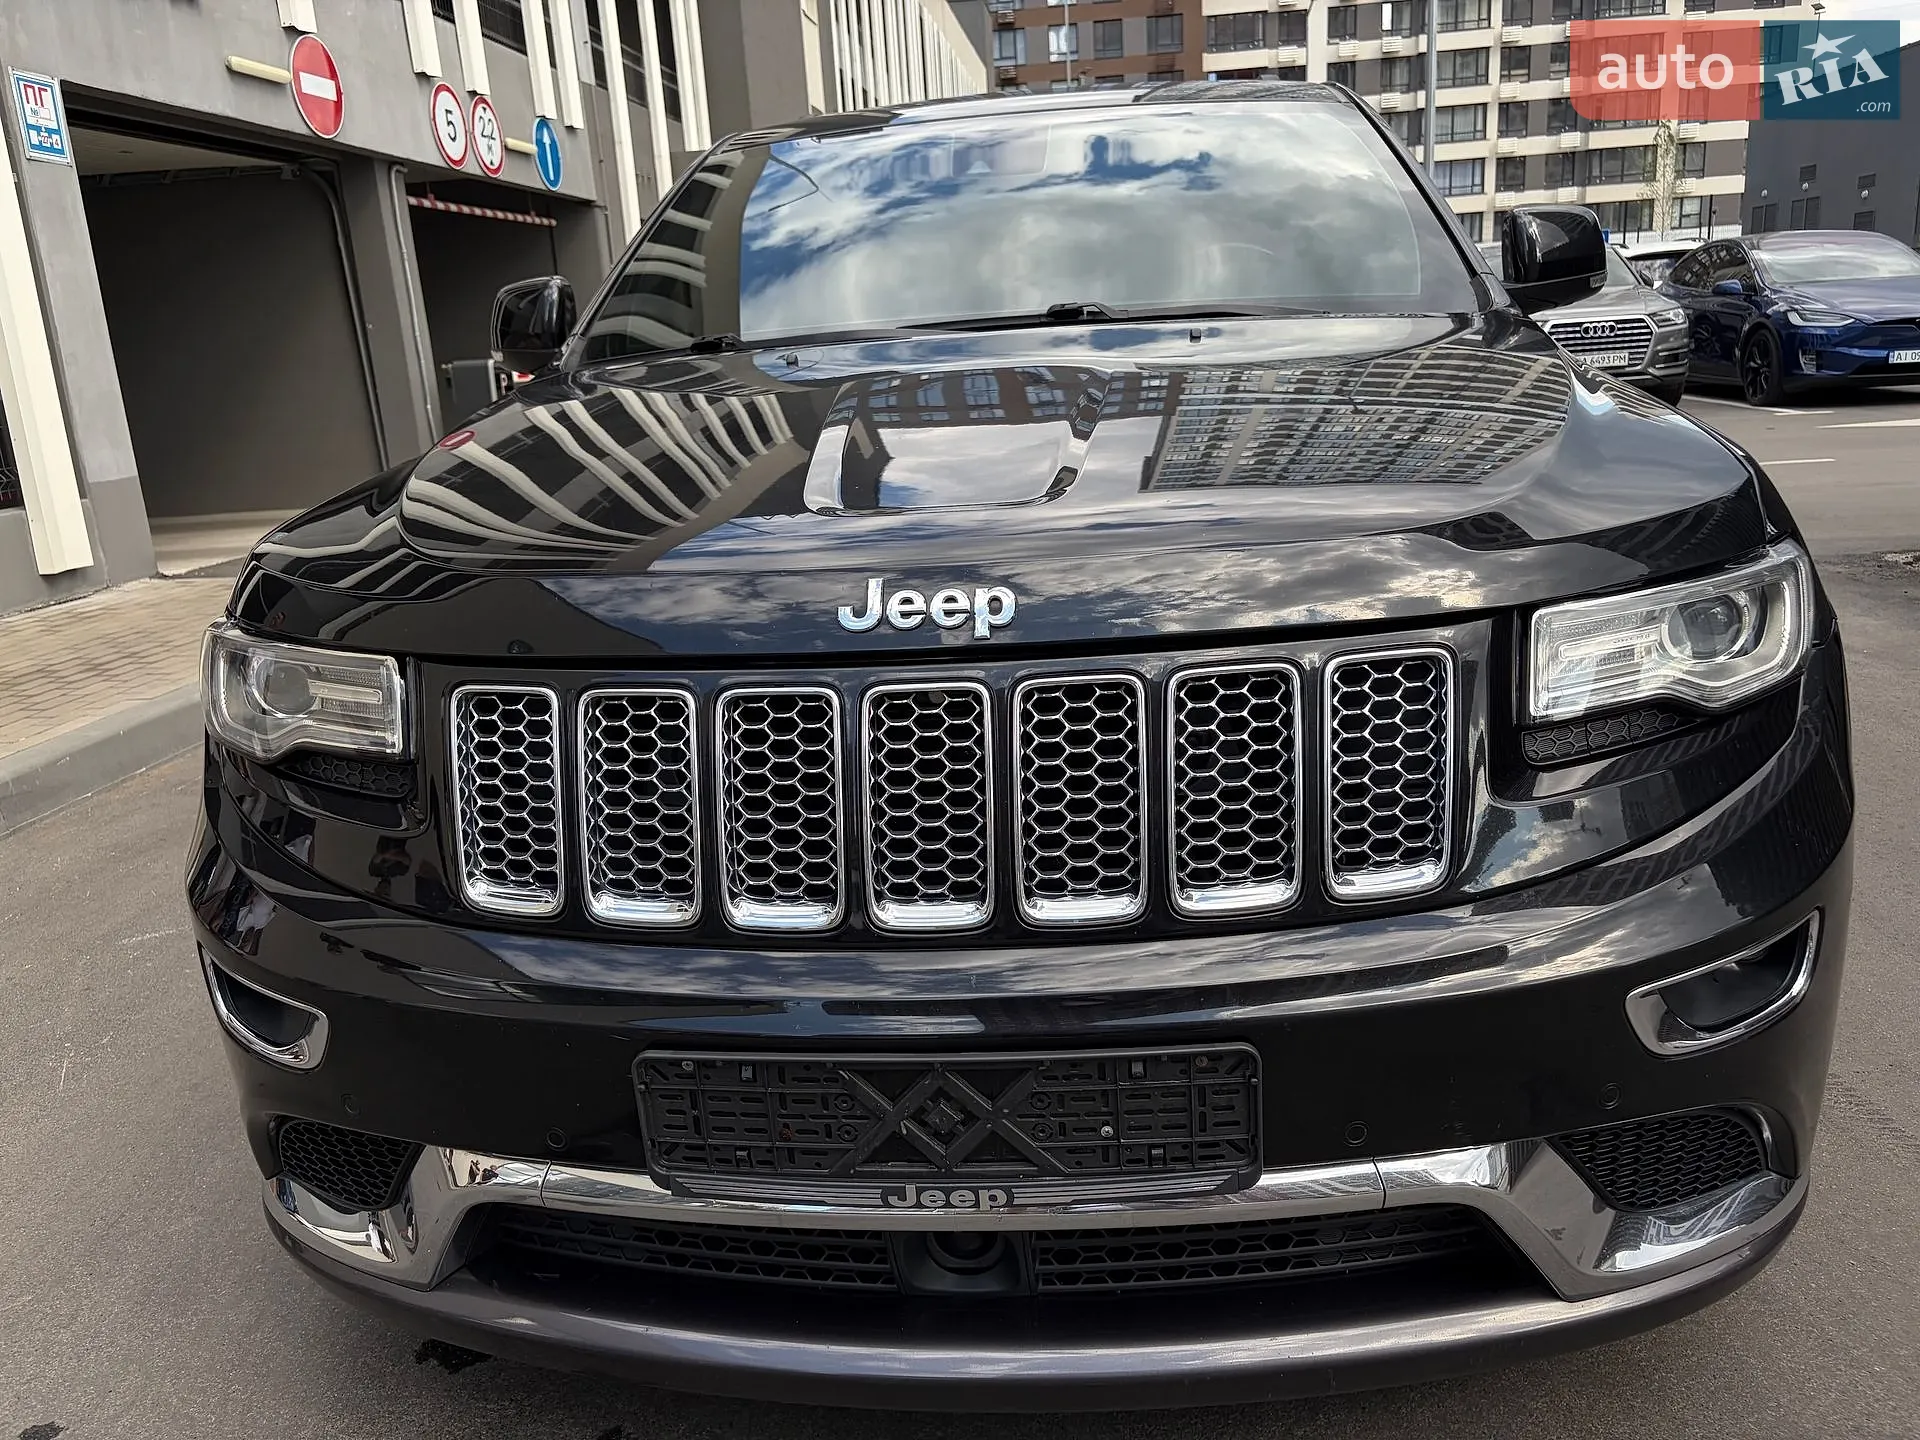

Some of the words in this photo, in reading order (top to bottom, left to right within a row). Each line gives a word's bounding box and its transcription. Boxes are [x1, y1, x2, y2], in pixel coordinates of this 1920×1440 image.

[23, 83, 48, 108] ПГ
[445, 109, 457, 143] 5
[838, 577, 1016, 640] Jeep
[887, 1183, 1008, 1211] Jeep
